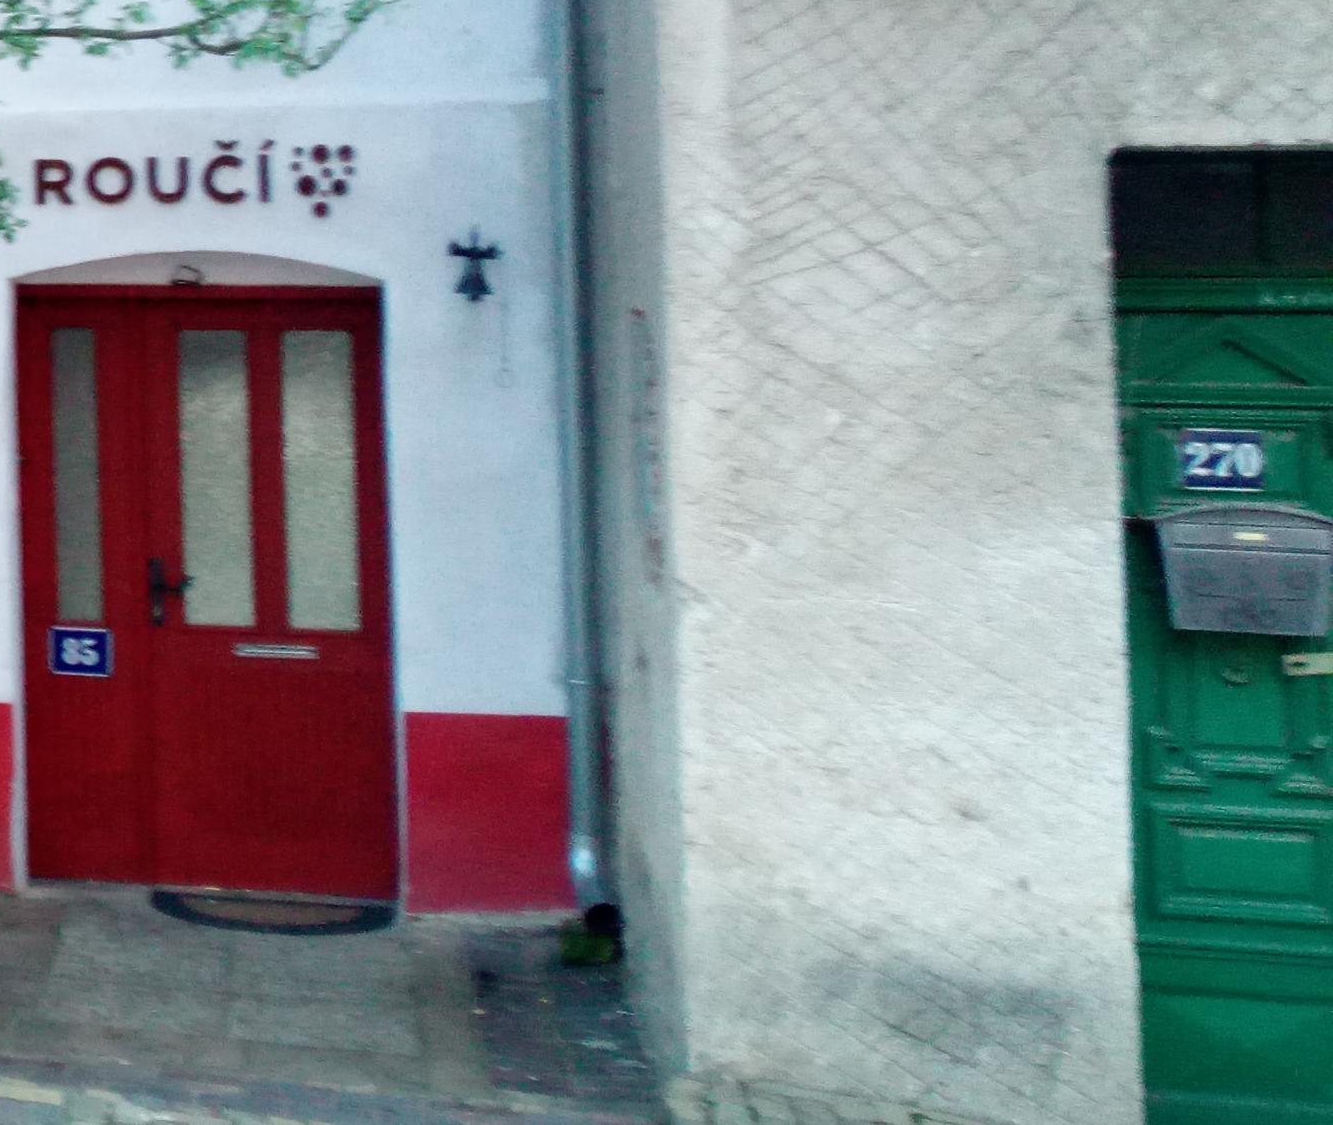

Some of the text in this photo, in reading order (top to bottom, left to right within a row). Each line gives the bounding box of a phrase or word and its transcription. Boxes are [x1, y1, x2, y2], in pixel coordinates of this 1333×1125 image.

[33, 139, 275, 205] ROUČÍ
[1183, 441, 1263, 478] 270
[60, 637, 101, 666] 85
